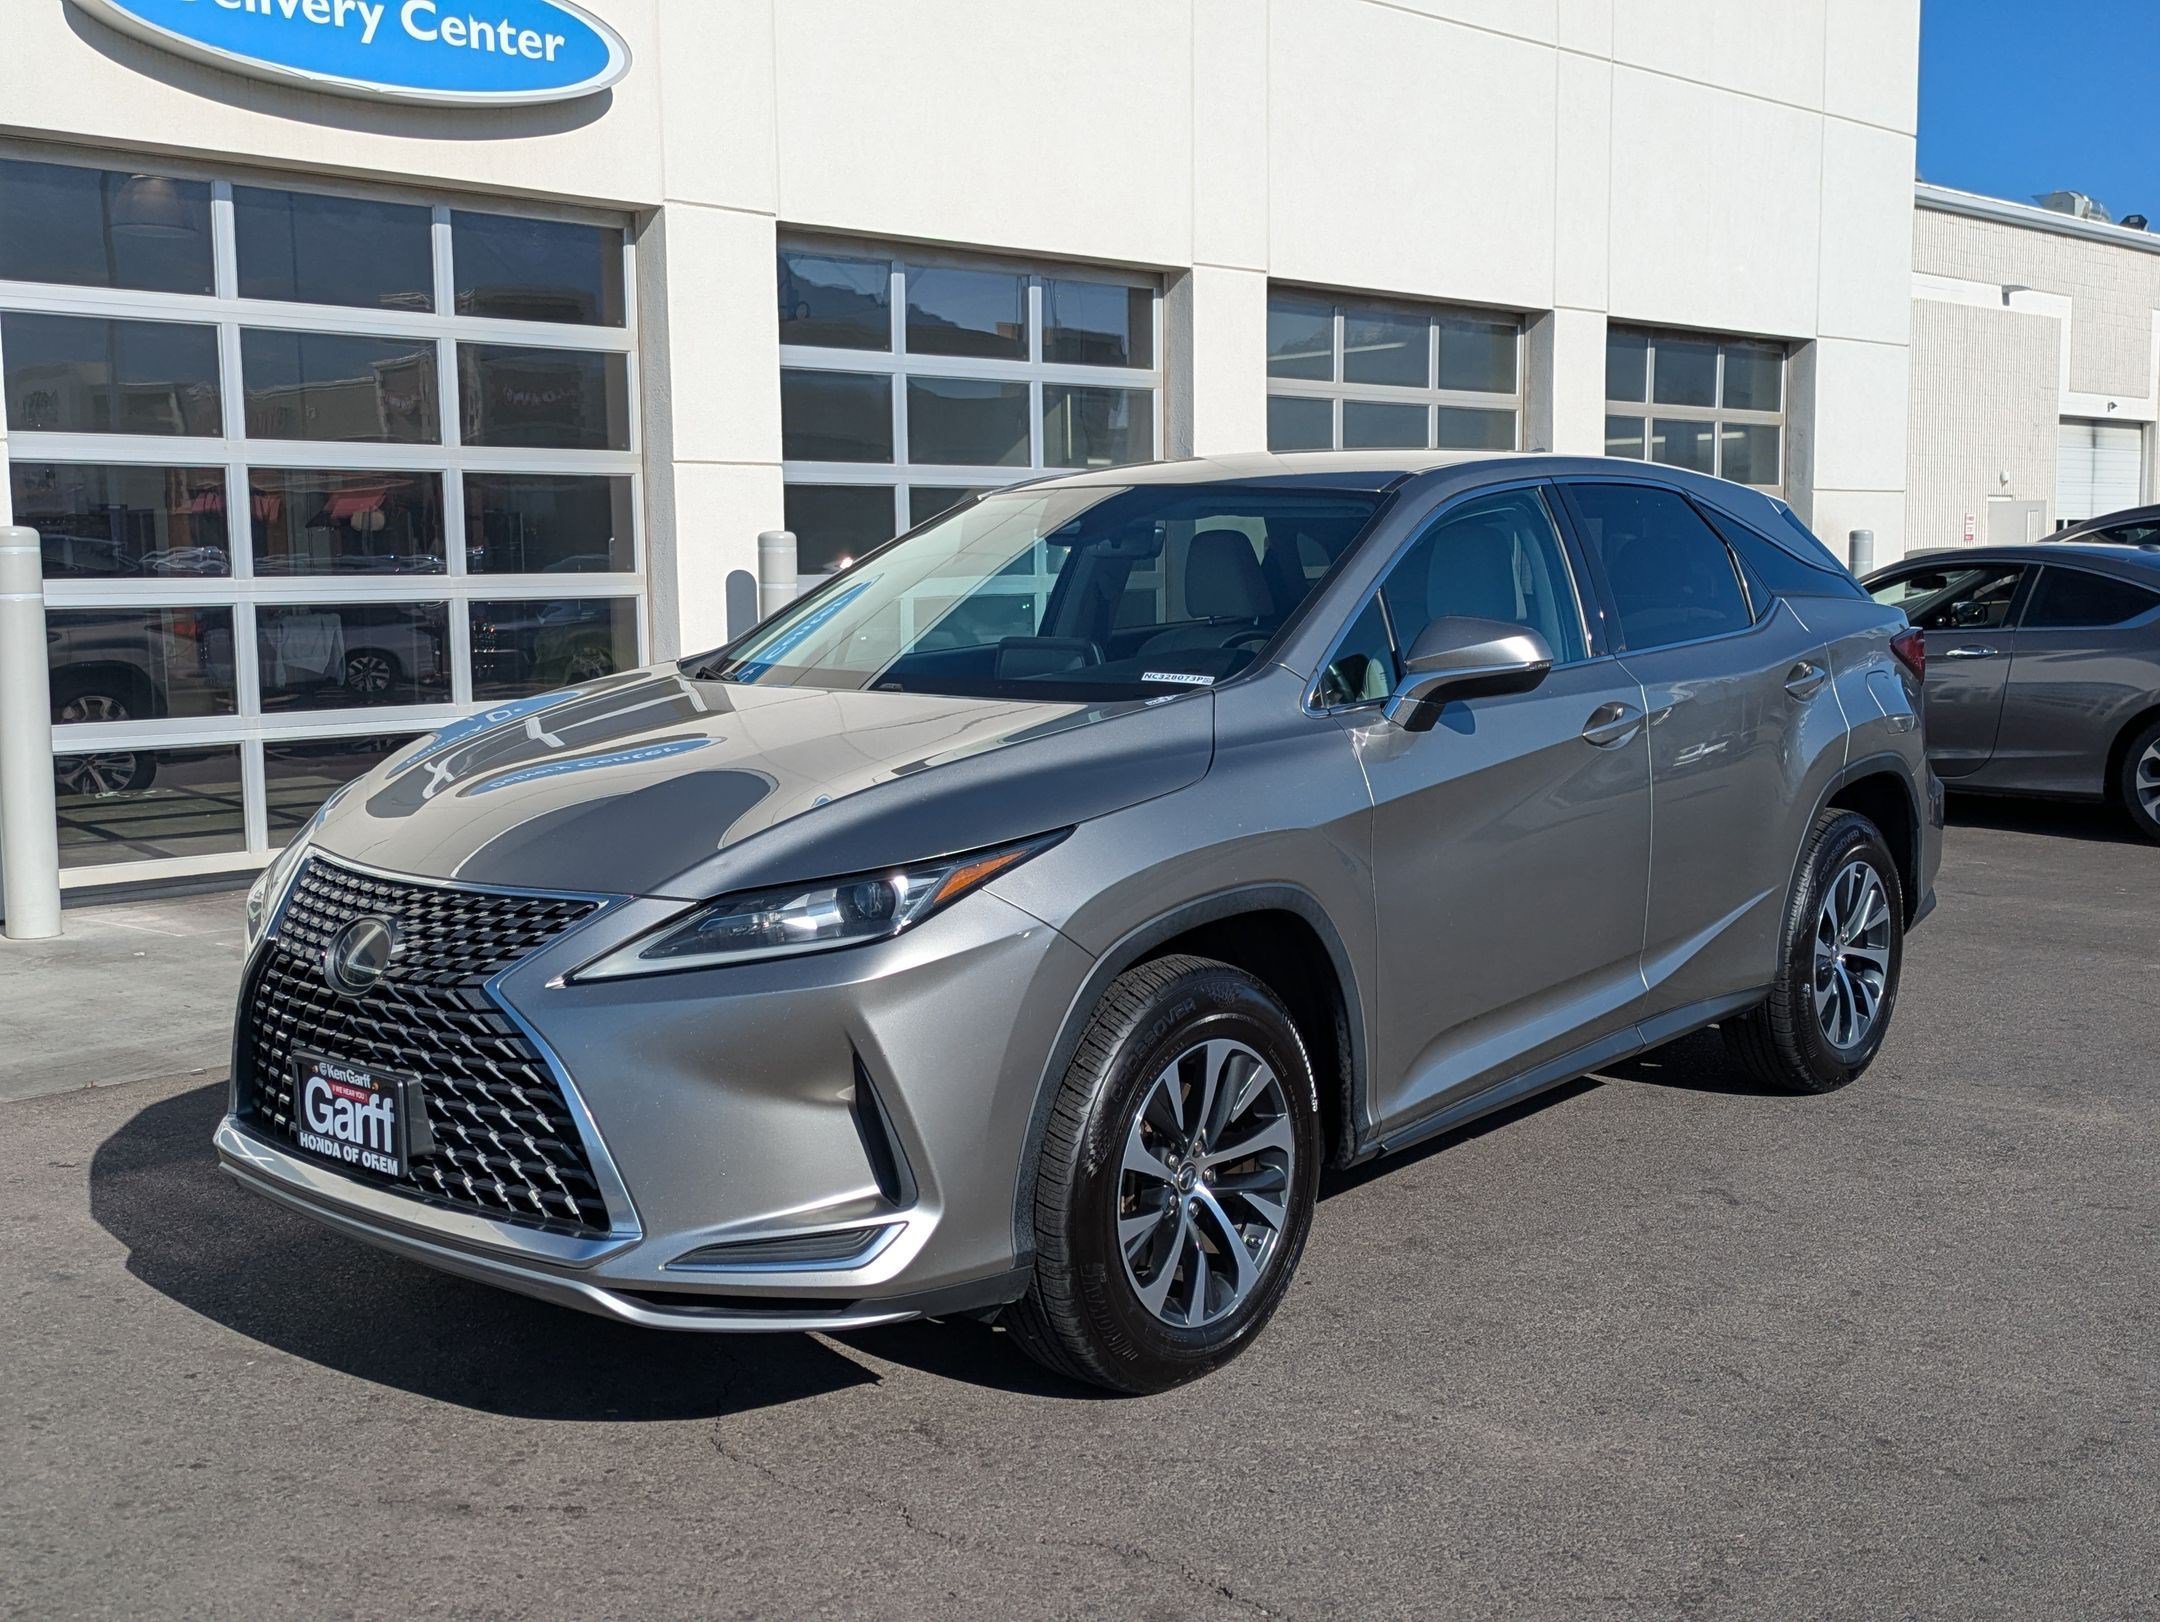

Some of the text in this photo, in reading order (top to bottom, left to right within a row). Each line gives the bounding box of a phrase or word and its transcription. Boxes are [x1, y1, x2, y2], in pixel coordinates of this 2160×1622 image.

[400, 0, 566, 62] Center
[305, 1076, 394, 1154] Garff
[300, 1131, 399, 1176] HONDA OF OREM
